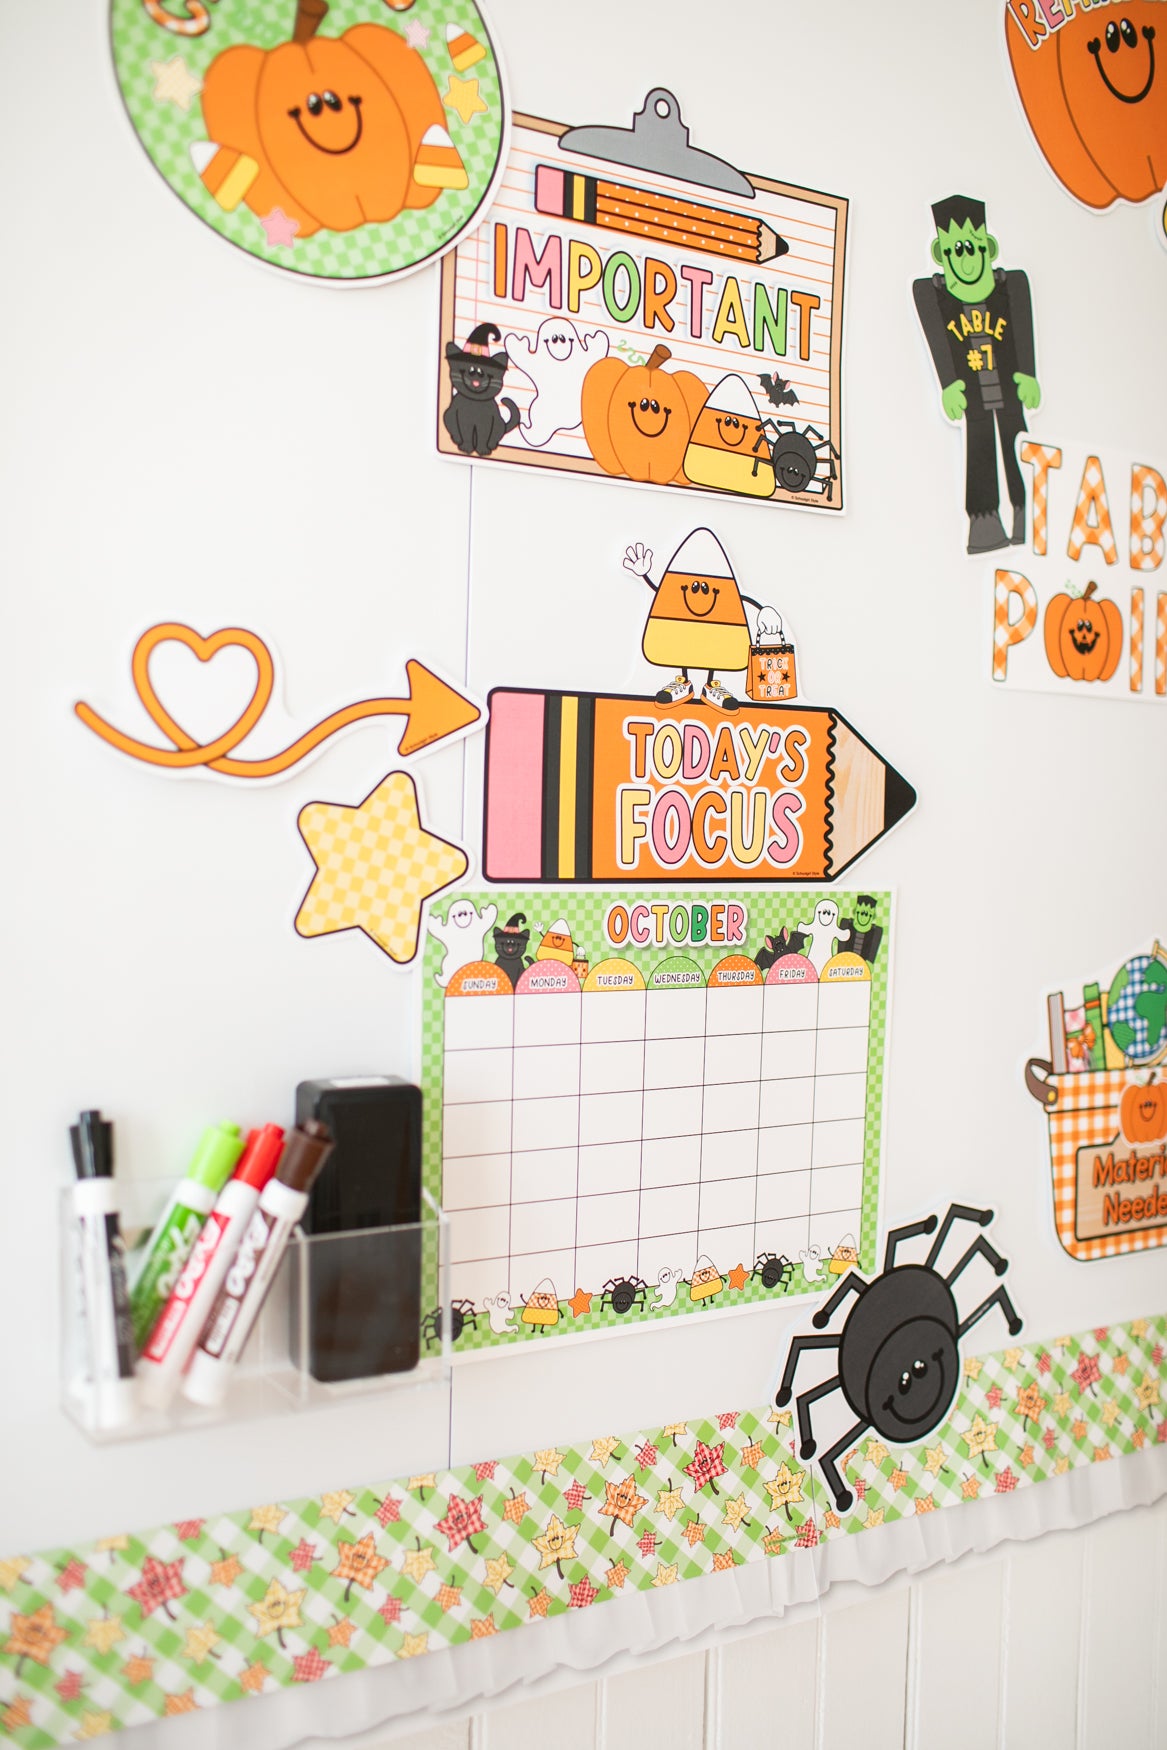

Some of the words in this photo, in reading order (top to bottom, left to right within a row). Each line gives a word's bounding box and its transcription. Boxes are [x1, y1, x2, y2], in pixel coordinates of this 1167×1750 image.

[494, 223, 820, 361] IMPORTANT
[947, 309, 1007, 342] TABLE
[967, 344, 993, 372] #7
[1020, 440, 1167, 572] TAB
[759, 657, 789, 670] TRICK
[767, 670, 782, 684] OR
[758, 684, 791, 698] TREAT
[627, 722, 807, 782] TODAY'S
[621, 789, 803, 864] FOCUS
[607, 905, 745, 943] OCTOBER
[654, 974, 701, 984] WEDNESDAY
[718, 971, 755, 981] THURSDAY
[779, 968, 806, 979] FRIDAY
[828, 967, 864, 977] SATURDAY
[462, 980, 498, 990] SUNDAY
[530, 977, 567, 988] MONDAY
[597, 975, 634, 985] TUESDAY
[1093, 1144, 1167, 1187] Materi
